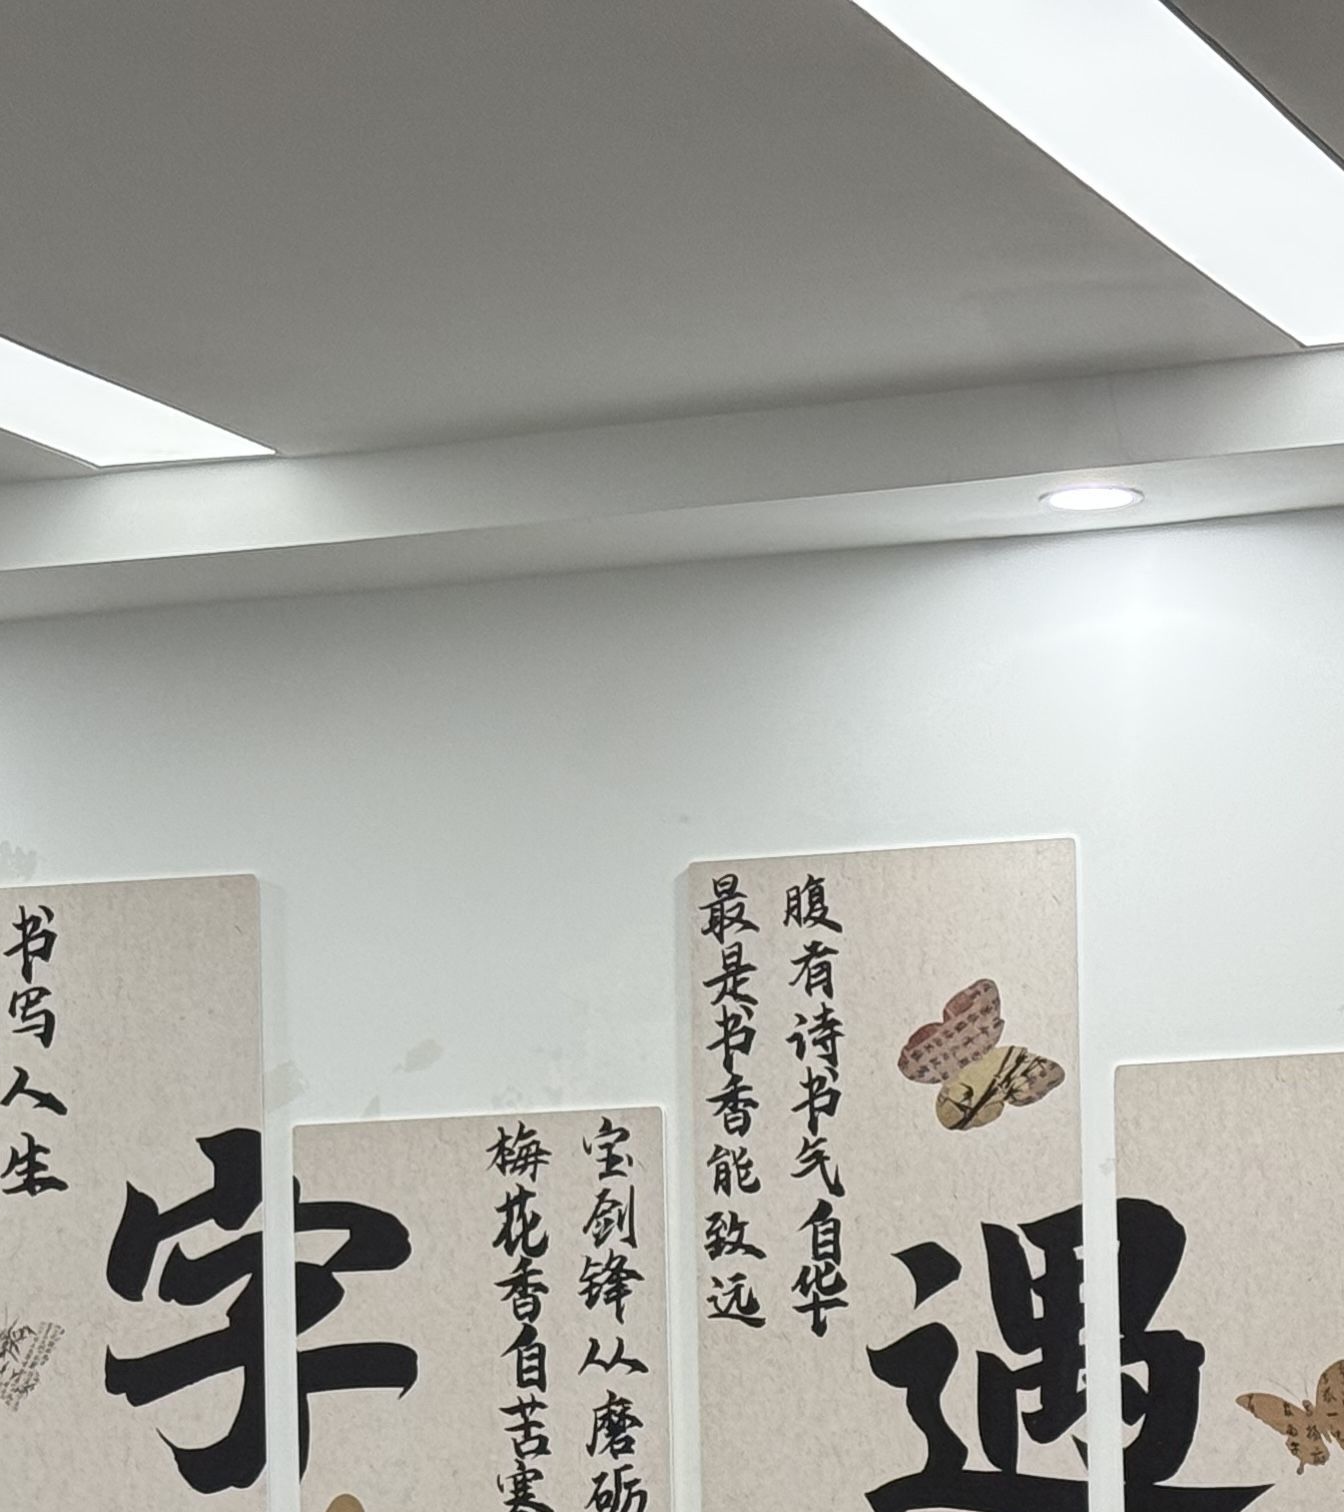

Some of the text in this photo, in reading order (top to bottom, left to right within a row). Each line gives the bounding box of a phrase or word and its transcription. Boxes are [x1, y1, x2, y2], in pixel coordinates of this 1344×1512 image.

[2, 905, 69, 1197] 书写人生
[699, 873, 767, 1329] 最是书香能致远
[784, 874, 849, 1337] 腹有诗书气自华
